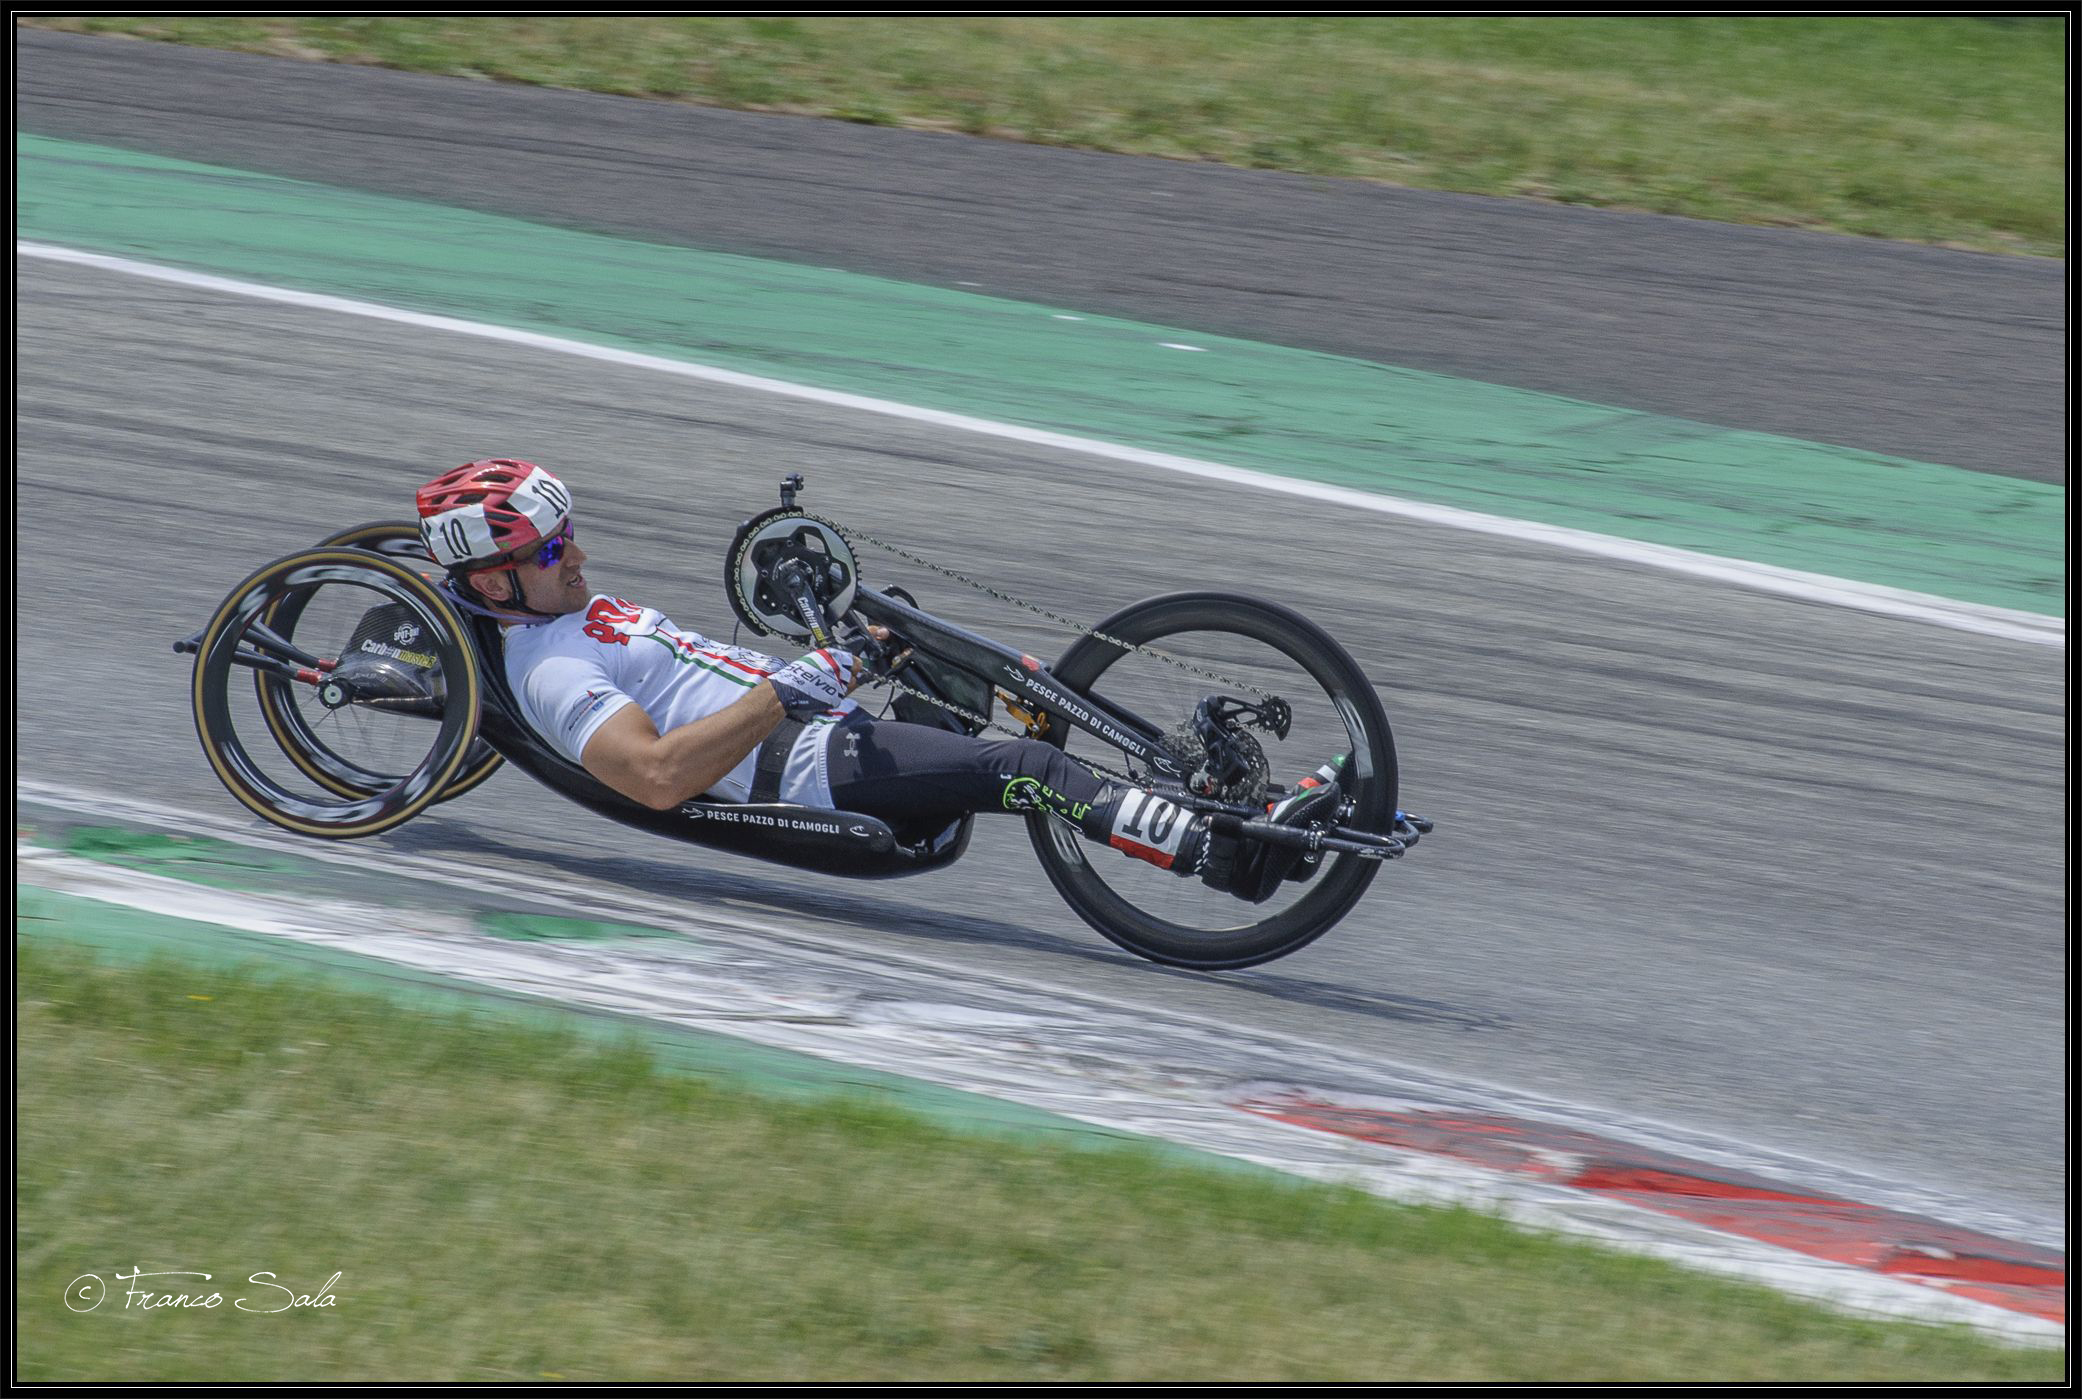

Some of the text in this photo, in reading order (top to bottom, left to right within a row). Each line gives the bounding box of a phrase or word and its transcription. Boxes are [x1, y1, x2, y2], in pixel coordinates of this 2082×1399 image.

[532, 479, 568, 519] 10
[439, 518, 472, 559] 10
[1026, 678, 1147, 756] PESCE PAZZO DI CAMOGLI
[707, 810, 840, 834] PESCE PAZZO DI CAMOGLI
[1121, 793, 1181, 845] 10
